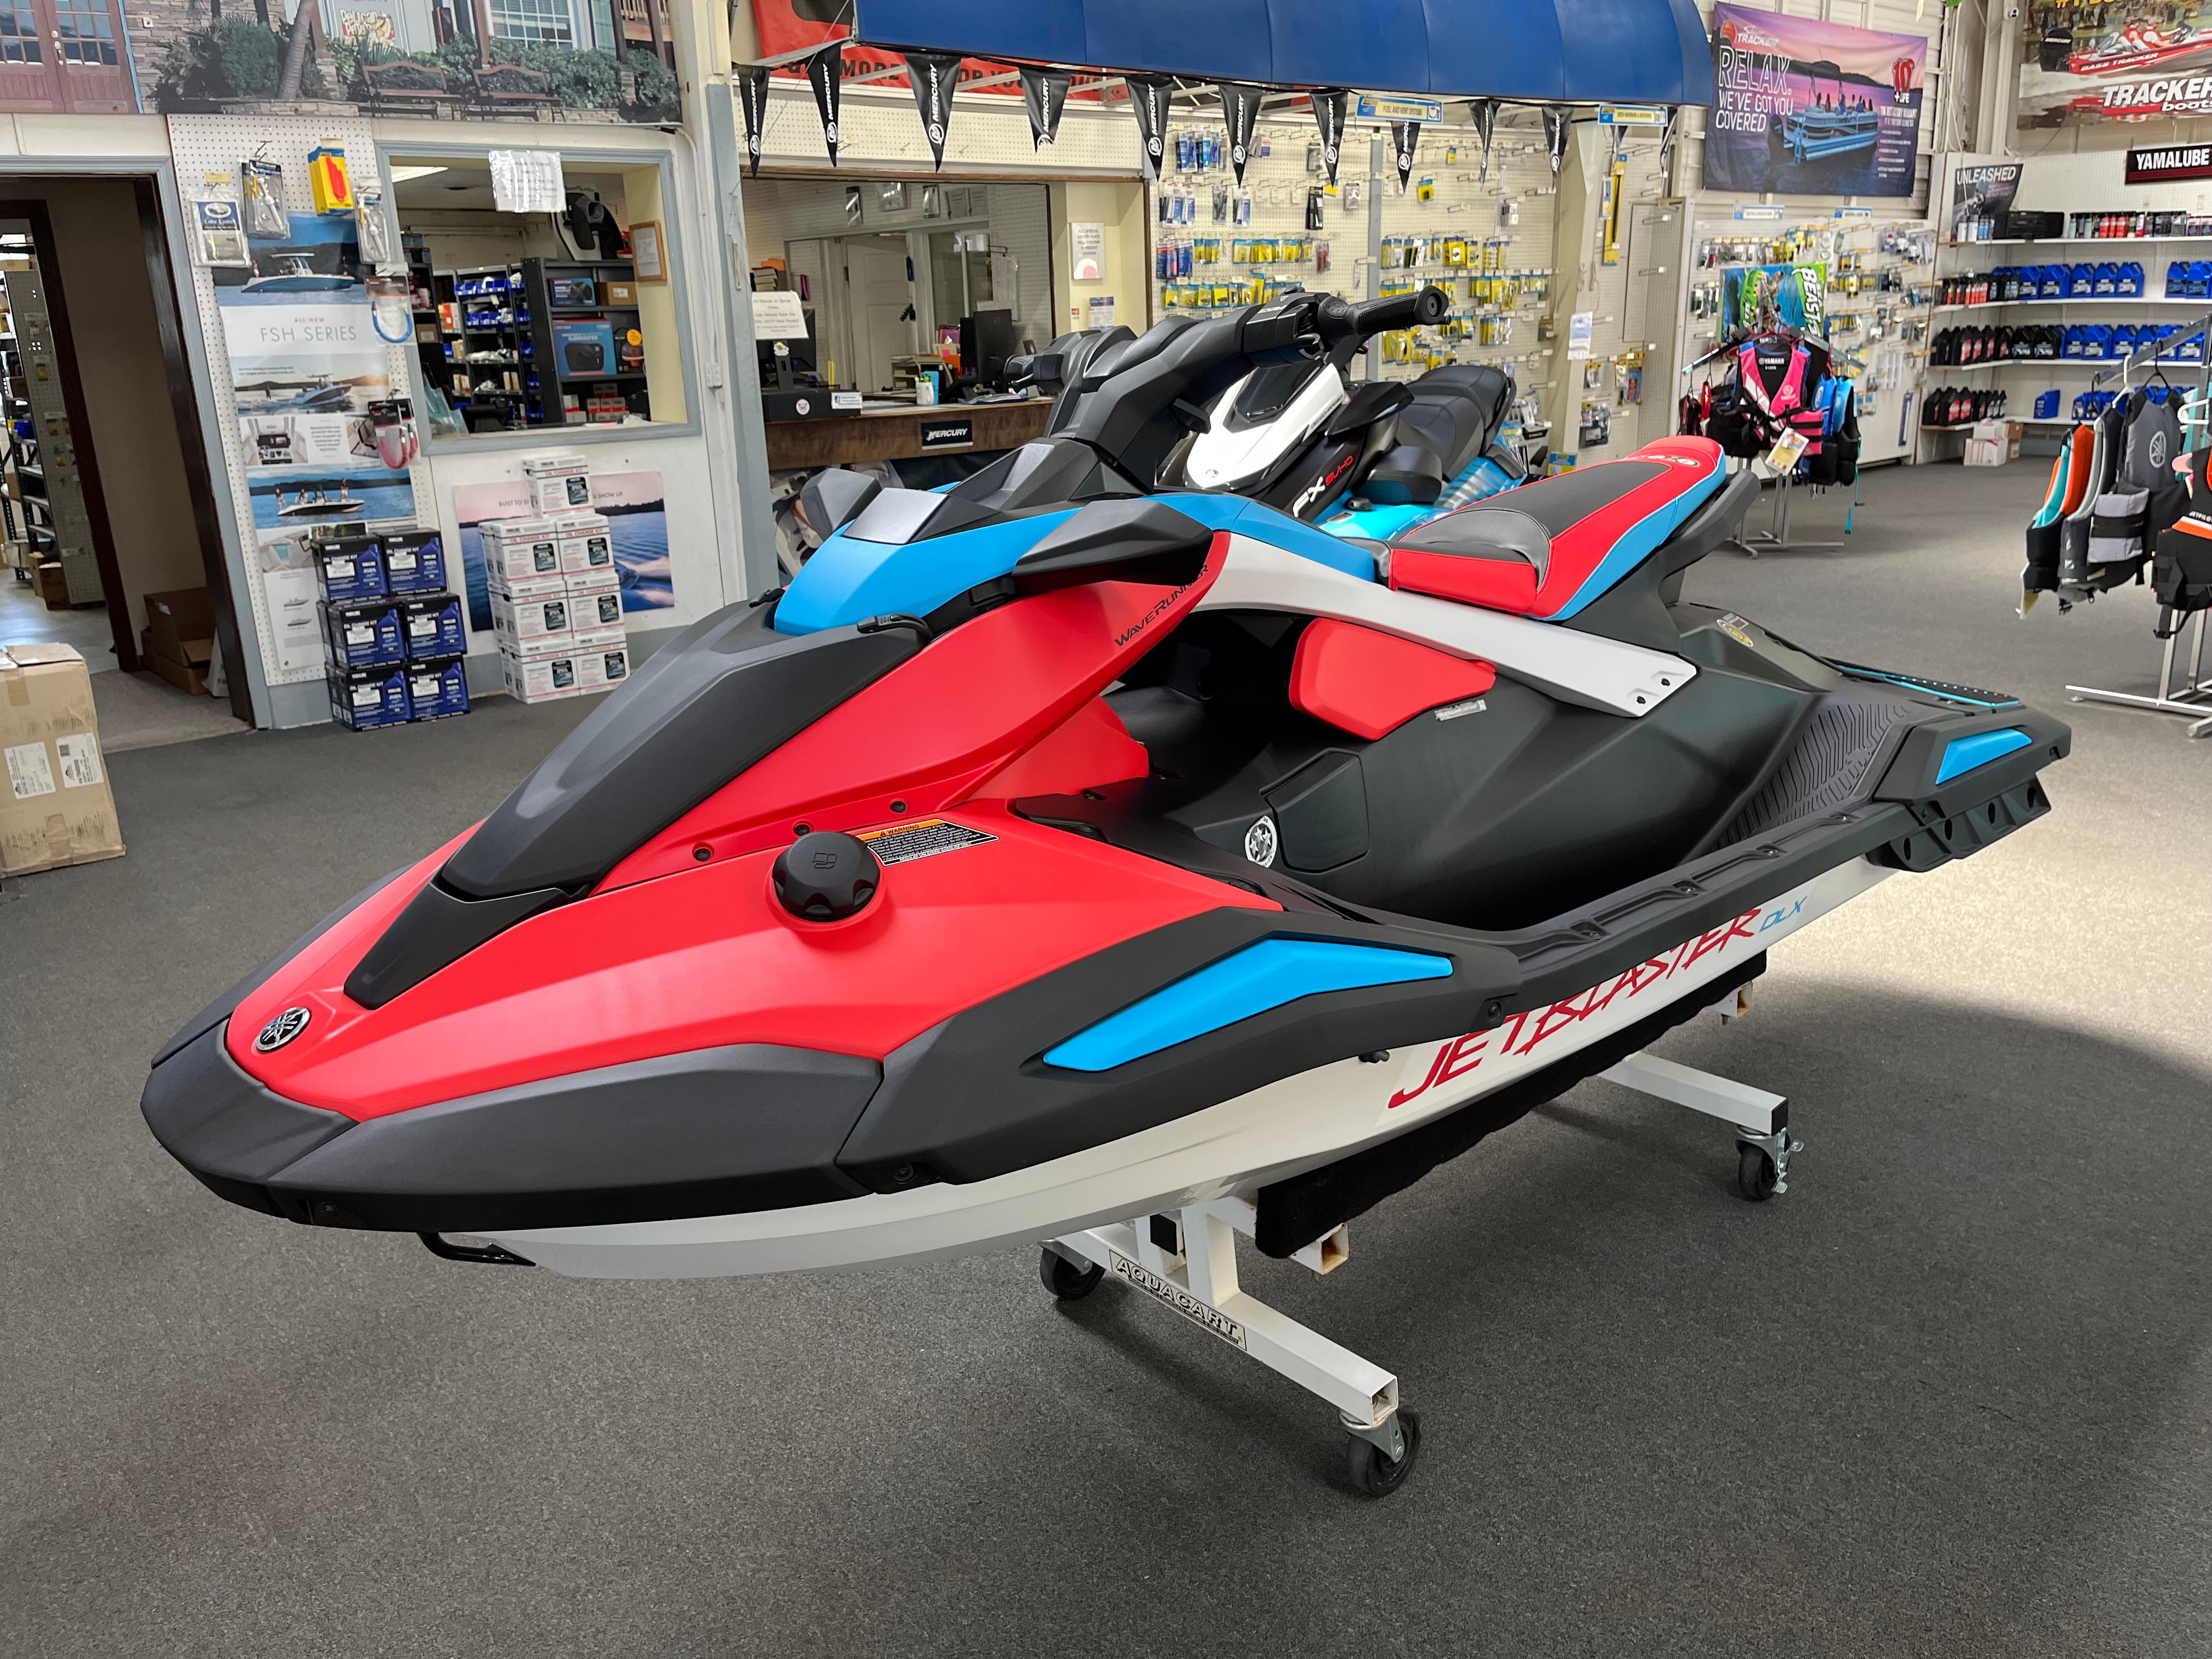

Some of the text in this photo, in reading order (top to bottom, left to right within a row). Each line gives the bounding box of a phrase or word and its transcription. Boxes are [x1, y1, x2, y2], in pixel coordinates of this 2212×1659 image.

[1738, 33, 1779, 48] TRACKER
[841, 59, 900, 80] MORE
[1719, 45, 1792, 95] RELAX.
[2080, 53, 2158, 71] BASS TRACKER
[823, 63, 834, 120] MERCURY
[930, 63, 940, 122] MERCURY
[1719, 89, 1793, 116] WE'VE GOT YOU
[2103, 77, 2212, 107] TRACKER
[750, 77, 758, 133] MERCURY
[1042, 77, 1051, 132] MERCURY
[1148, 83, 1159, 136] MERCURY
[1409, 108, 1422, 116] SYSTEMS
[1716, 110, 1767, 132] COVERED
[2136, 148, 2210, 170] YAMALUBE
[1957, 166, 2016, 185] UNLEASHED
[261, 326, 357, 342] FSH SERIES
[927, 428, 968, 441] MERCURY
[1293, 455, 1353, 517] FX SVHO
[2189, 510, 2212, 523] JETPILO
[888, 825, 919, 834] WARNING
[1389, 896, 1808, 1108] JETBLASTER DLX
[1116, 1258, 1237, 1335] AQUACART
